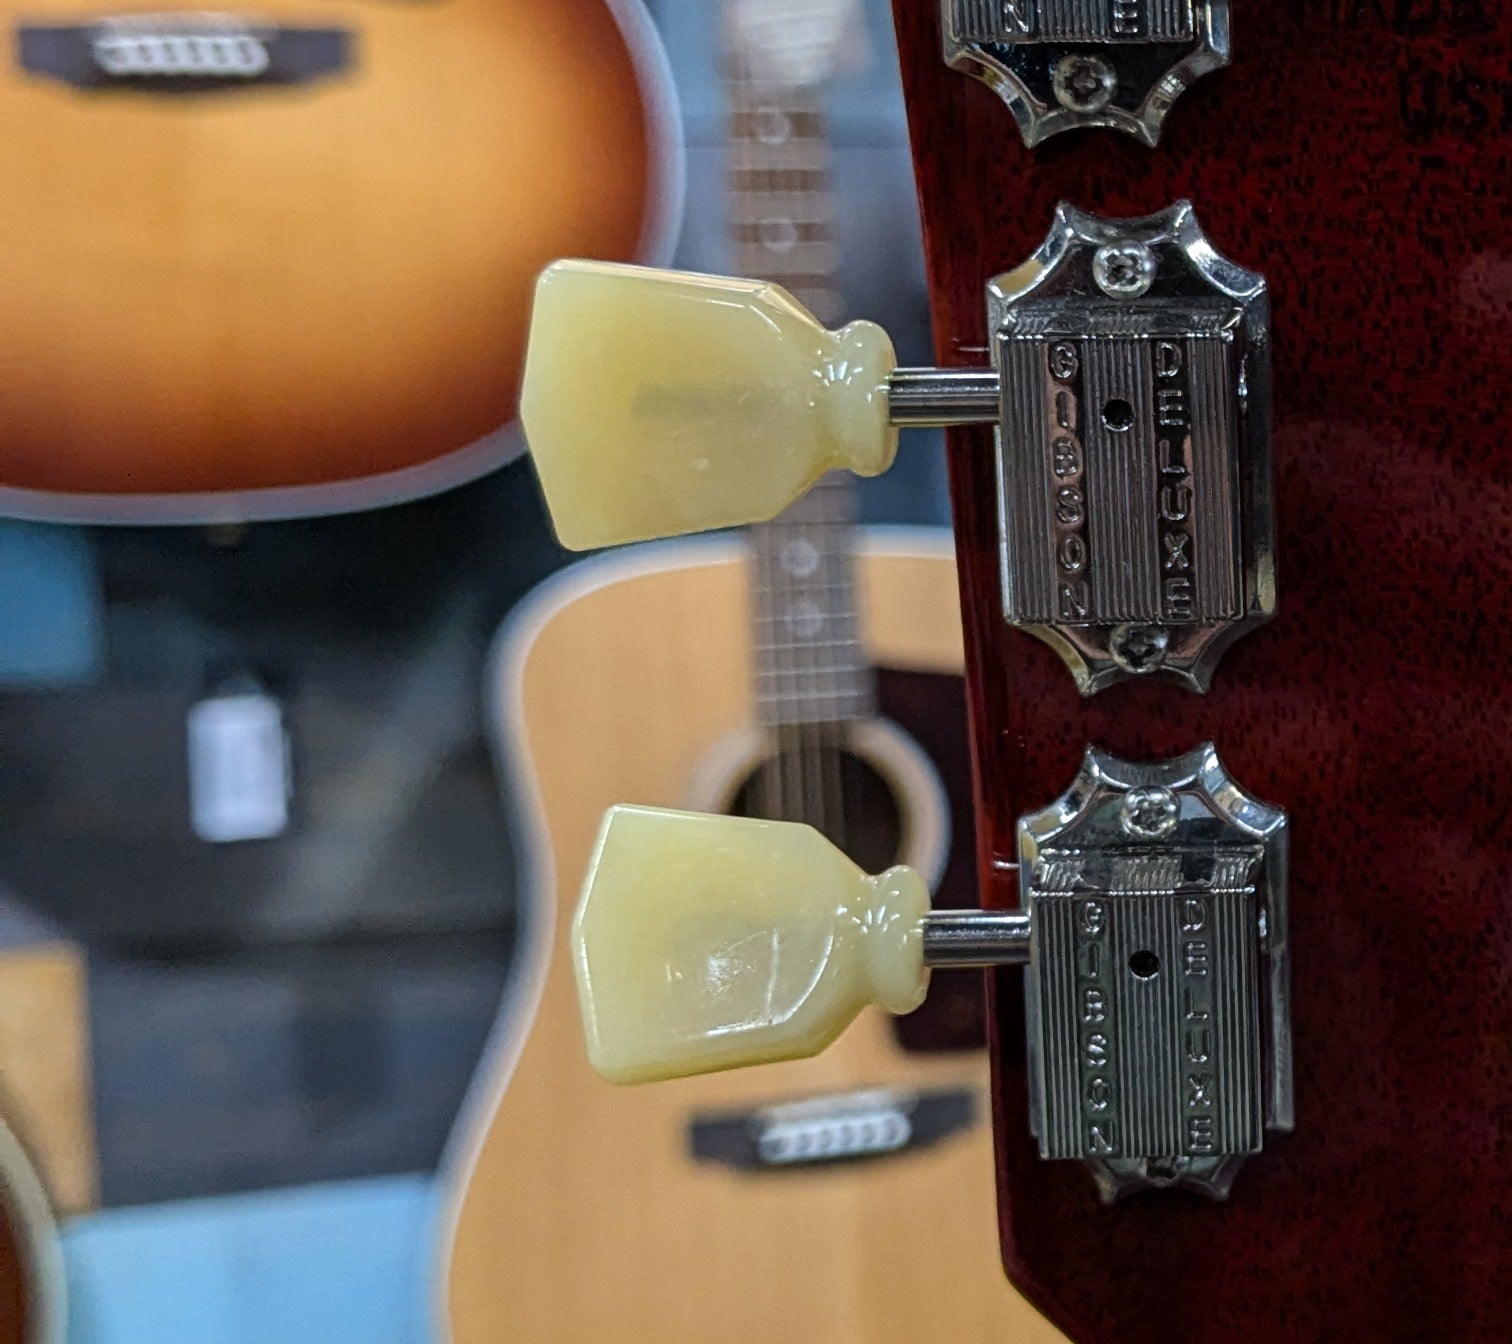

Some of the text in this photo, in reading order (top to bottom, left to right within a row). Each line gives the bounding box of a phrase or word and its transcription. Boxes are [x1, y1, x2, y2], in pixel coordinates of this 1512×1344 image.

[1050, 342, 1088, 618] GIBSON
[1156, 342, 1193, 617] DELUXE
[1082, 901, 1114, 1153] GIBSON
[1183, 899, 1214, 1153] DELUXE
